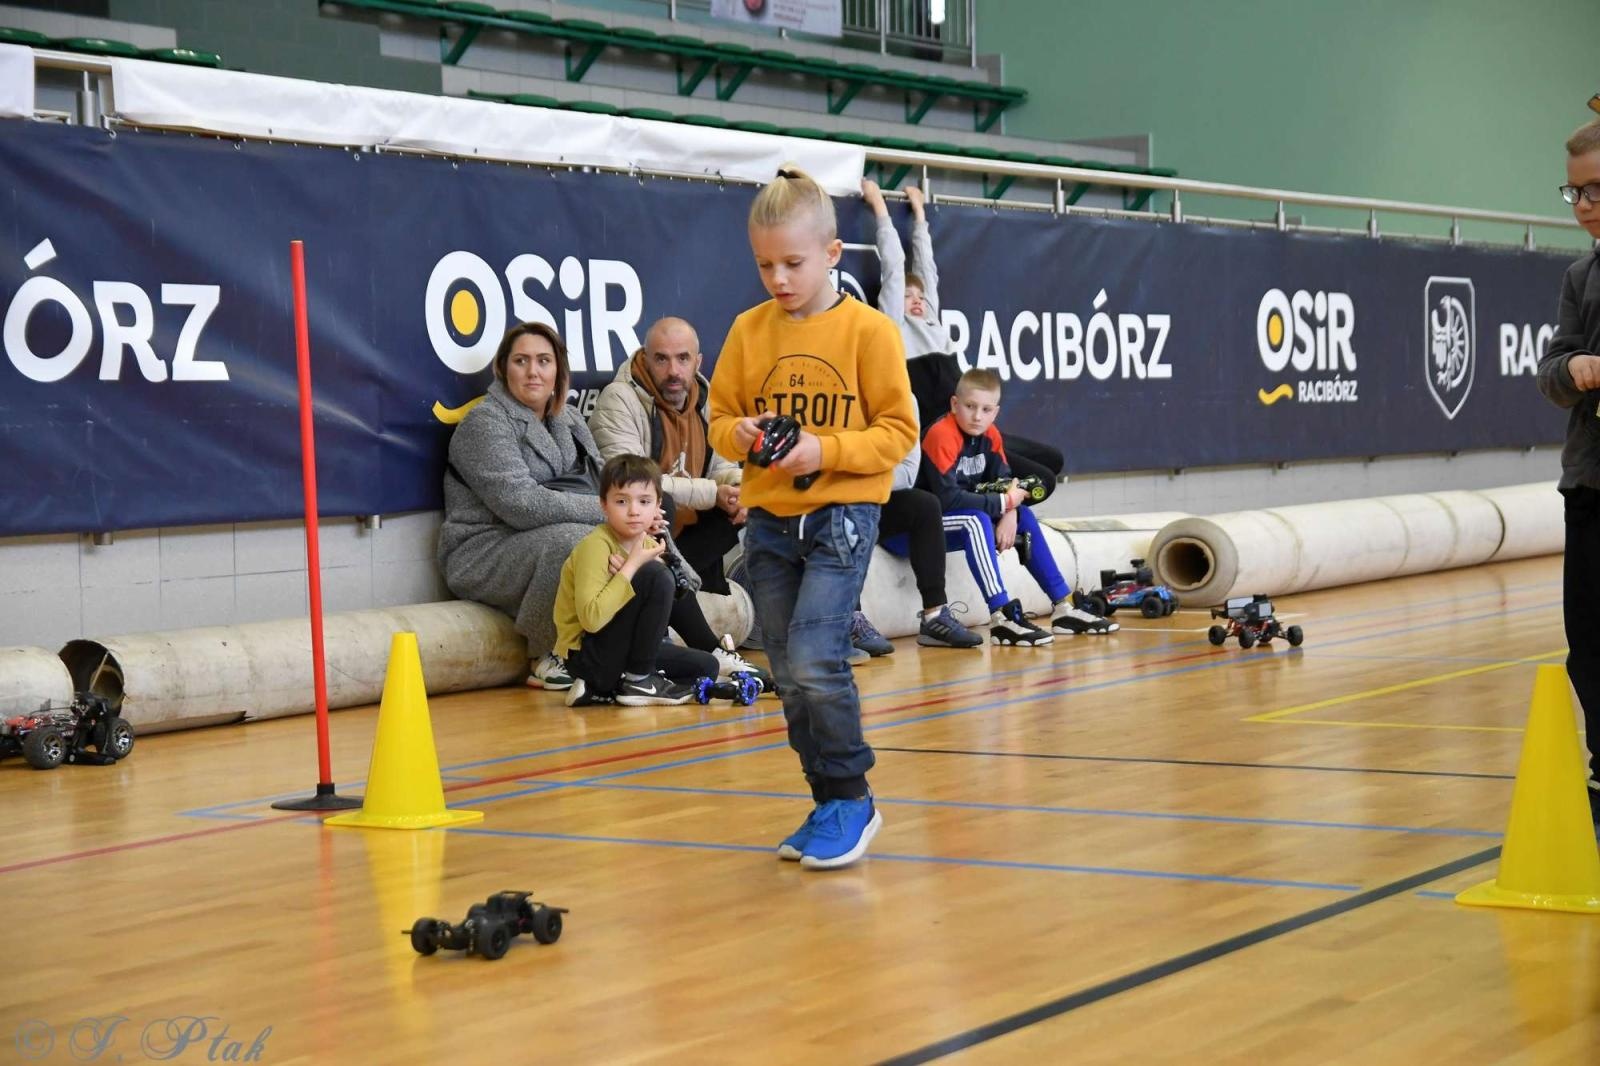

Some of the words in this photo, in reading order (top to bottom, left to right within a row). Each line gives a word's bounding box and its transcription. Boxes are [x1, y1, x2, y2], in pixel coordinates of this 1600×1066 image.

[3, 238, 230, 382] ÓRZ
[425, 250, 643, 375] OSiR
[941, 287, 1173, 381] RACIBÓRZ
[1257, 288, 1357, 372] OSiR
[789, 373, 805, 387] 64
[1500, 322, 1560, 376] RAC
[754, 392, 856, 428] DTROIT
[1298, 374, 1358, 402] RACIBÓRZ
